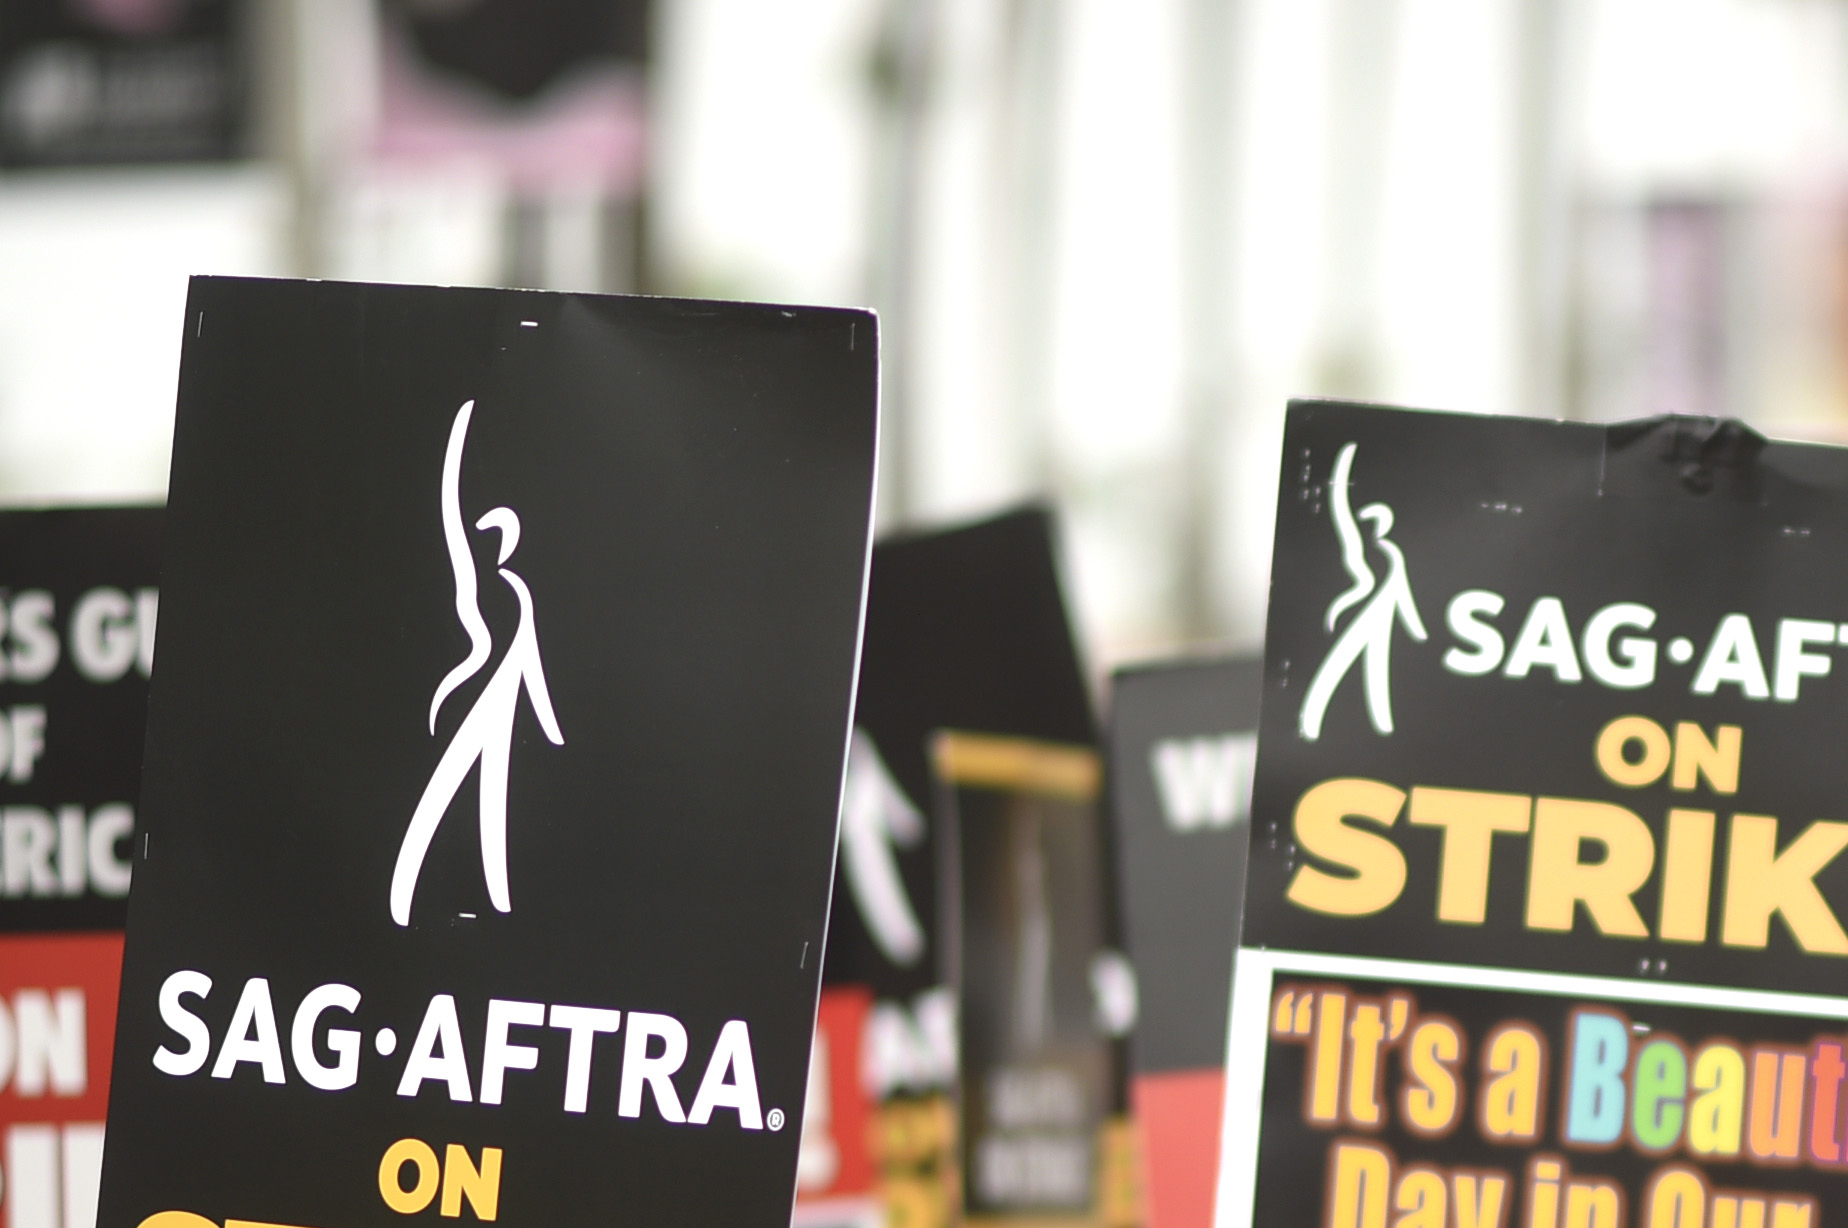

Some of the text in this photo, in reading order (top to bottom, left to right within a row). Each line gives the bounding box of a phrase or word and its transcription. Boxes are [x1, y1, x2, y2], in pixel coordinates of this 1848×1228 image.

[1596, 716, 1742, 793] ON
[1486, 1028, 1541, 1137] a
[378, 1138, 503, 1222] ON
